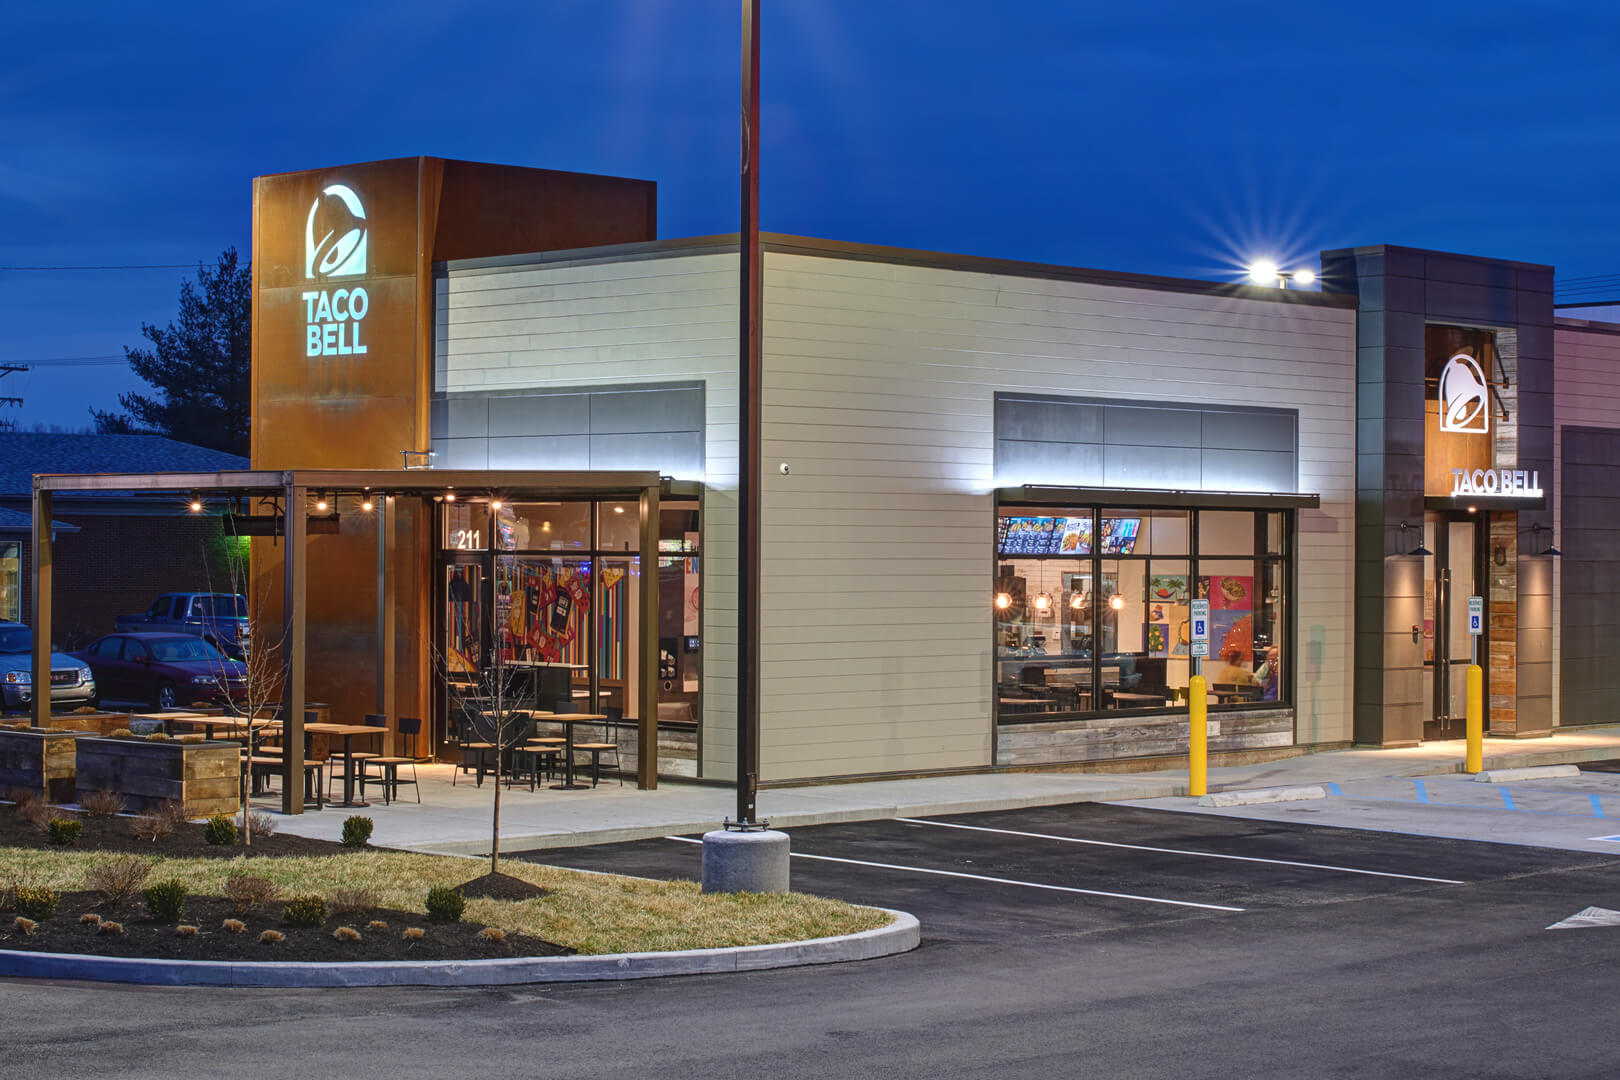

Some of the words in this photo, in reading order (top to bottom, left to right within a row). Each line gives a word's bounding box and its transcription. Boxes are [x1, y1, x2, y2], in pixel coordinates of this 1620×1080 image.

[302, 287, 369, 323] TACO
[307, 321, 368, 357] BELL
[1451, 468, 1498, 495] TACO
[1501, 470, 1543, 497] BELL
[458, 529, 480, 549] 211
